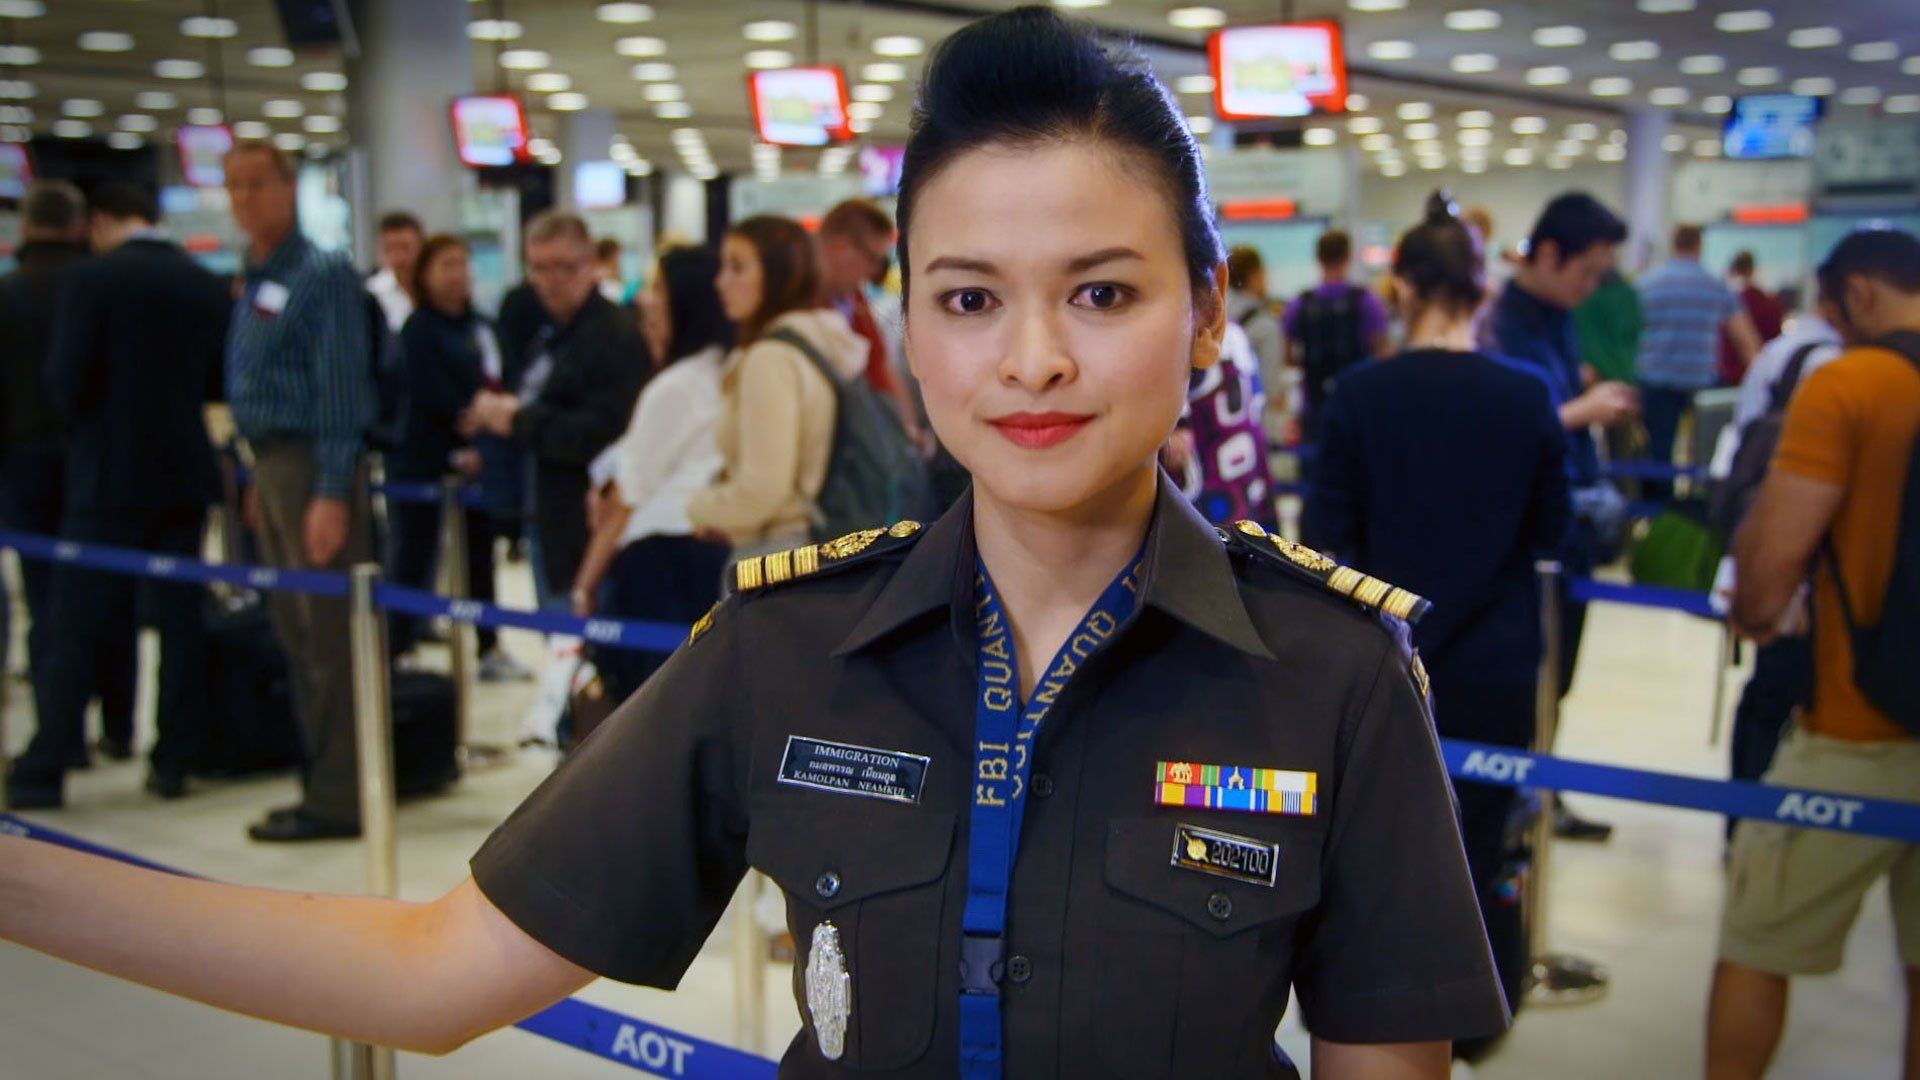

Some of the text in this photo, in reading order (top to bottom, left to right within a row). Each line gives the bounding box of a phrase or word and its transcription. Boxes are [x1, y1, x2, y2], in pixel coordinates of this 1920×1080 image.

[814, 745, 899, 767] IMMIGRATION
[1461, 750, 1536, 783] AOT
[793, 770, 905, 797] KAMOLPAN NEAMKUL
[975, 740, 1010, 806] FBI
[1775, 792, 1864, 828] AOT
[1211, 841, 1269, 874] 202100
[611, 1022, 695, 1076] AOT
